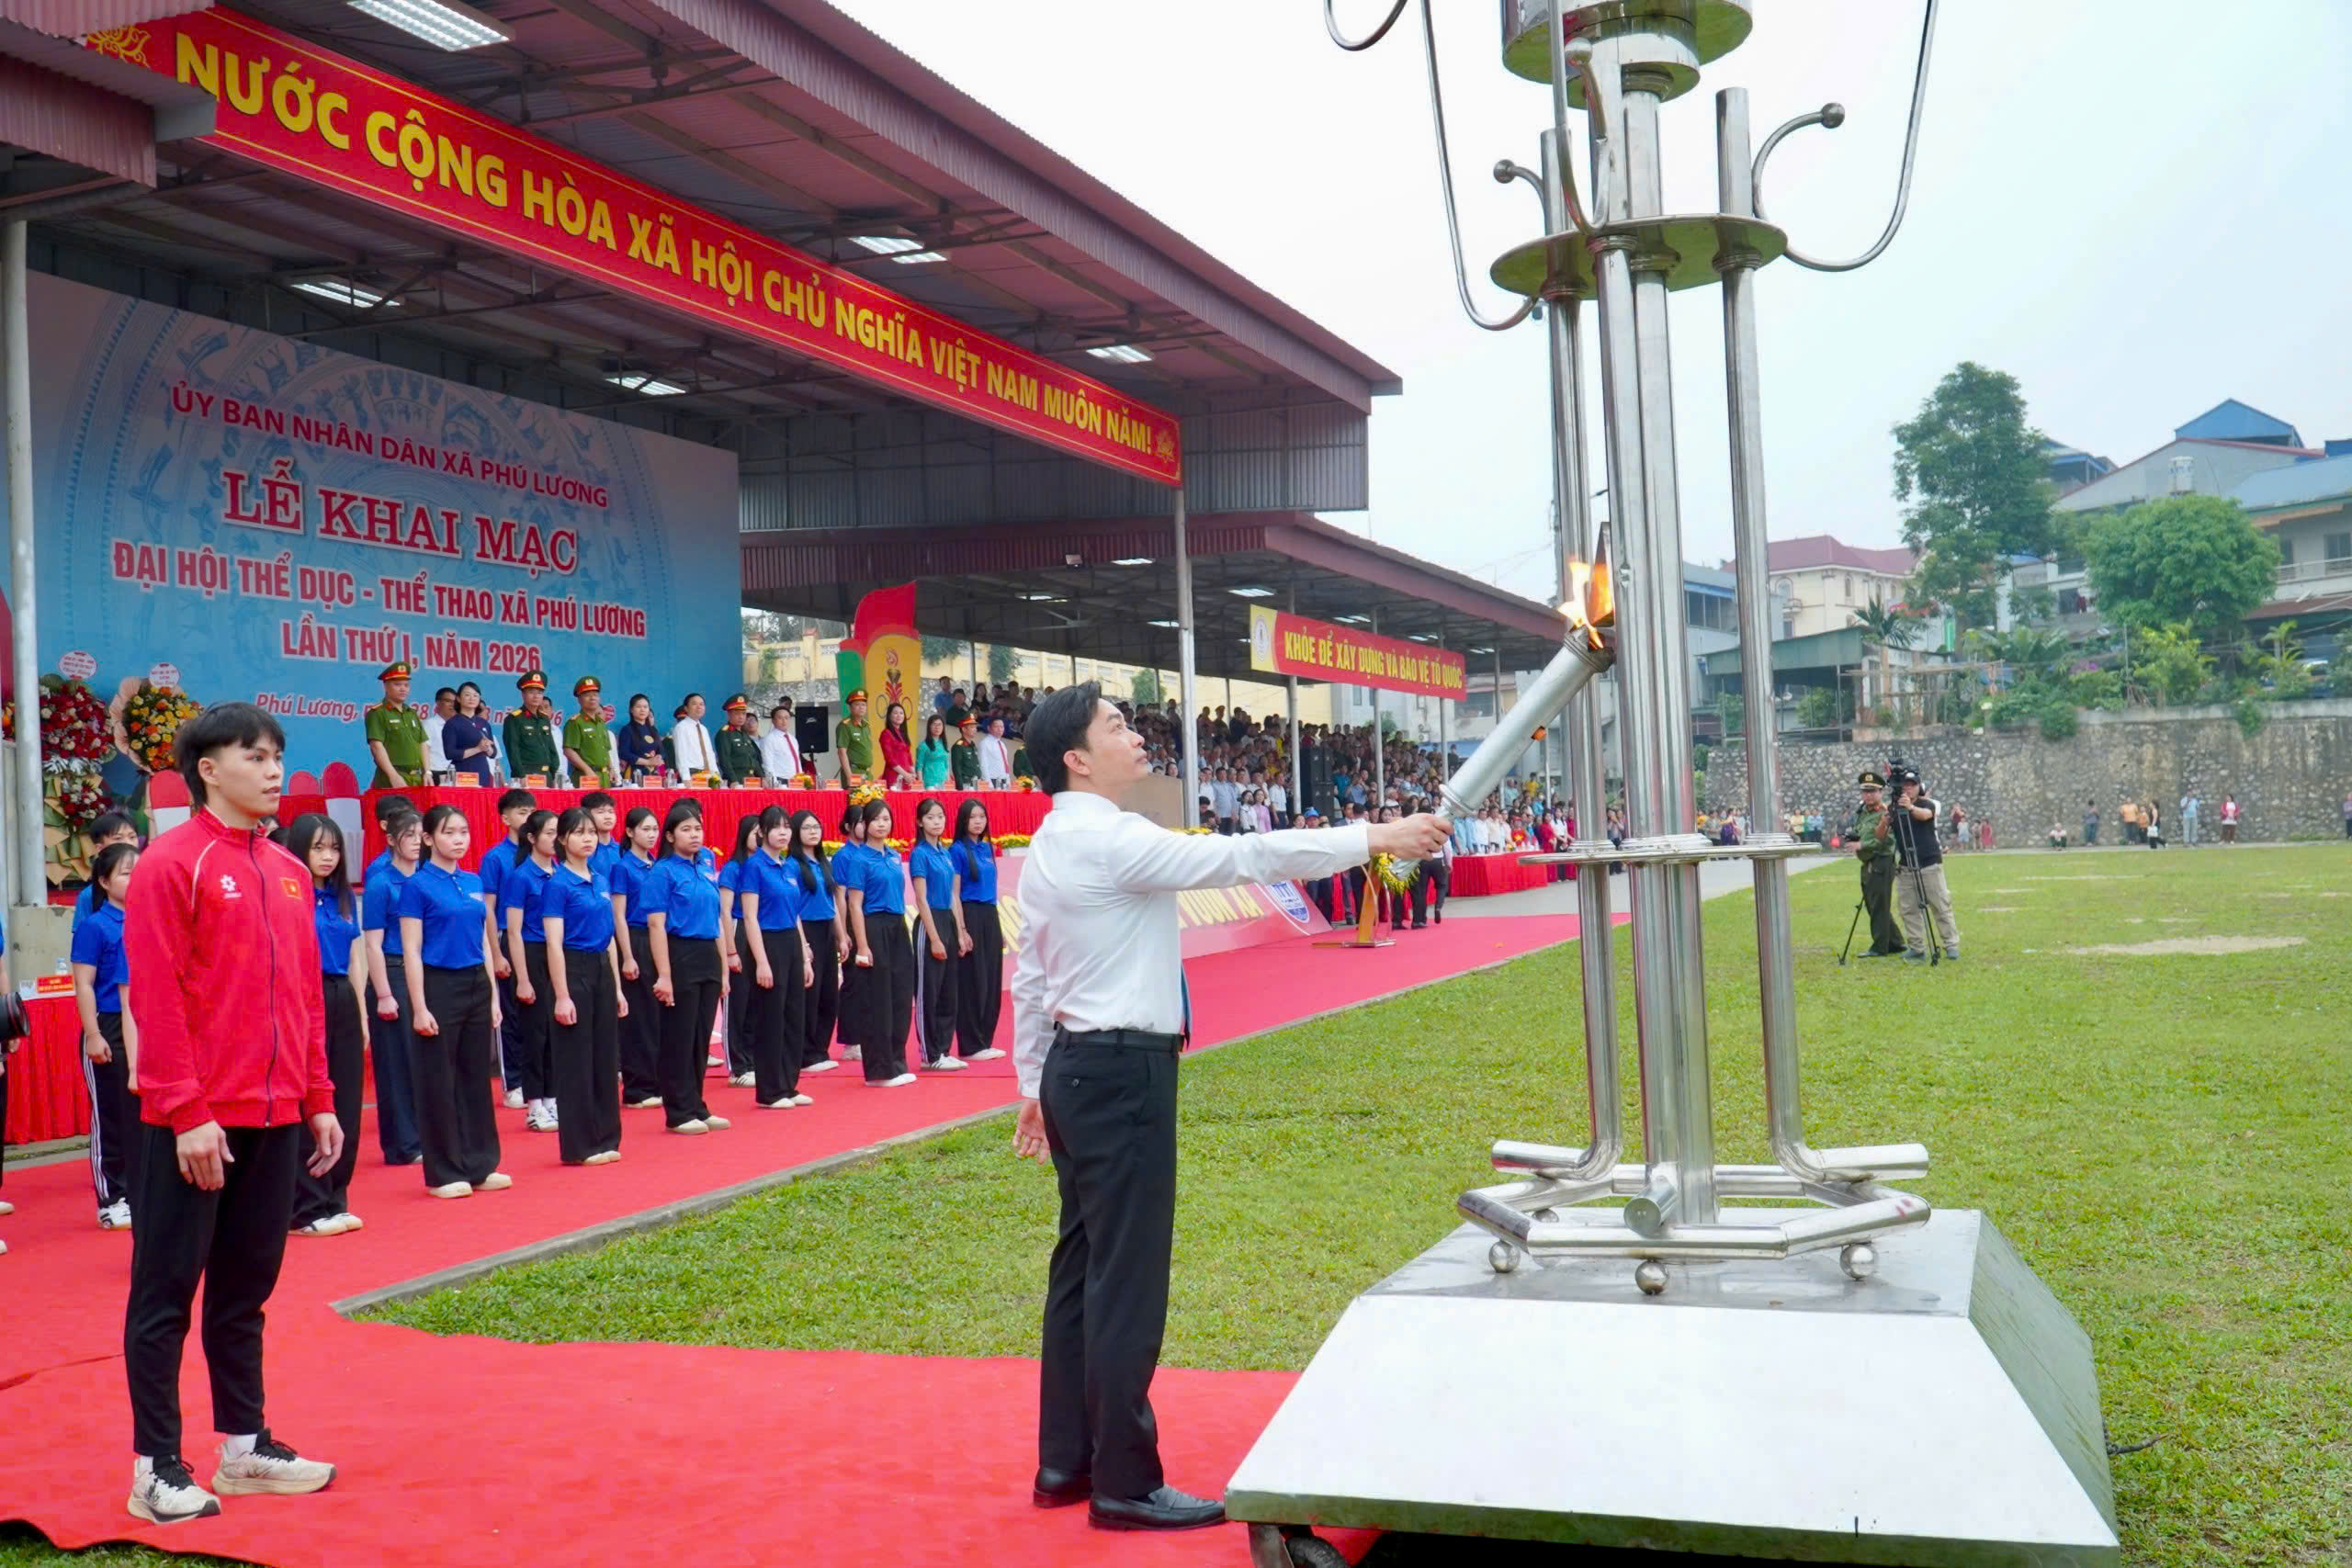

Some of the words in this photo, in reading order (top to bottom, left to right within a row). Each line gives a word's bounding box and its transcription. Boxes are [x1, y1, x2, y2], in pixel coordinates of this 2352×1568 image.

[176, 32, 350, 150] NƯỚC
[366, 108, 507, 207] CỘNG
[522, 169, 617, 251] HÒA
[628, 212, 682, 276] XÃ
[691, 239, 752, 307] HỘI
[763, 272, 826, 329] CHỦ
[835, 297, 924, 368] NGHĨA
[930, 338, 982, 393] VIỆT
[987, 359, 1037, 412] NAM
[1044, 389, 1102, 434] MUÔN
[1106, 405, 1152, 454] NĂM!
[172, 380, 214, 417] ỦY
[223, 399, 284, 434] BAN
[292, 415, 373, 455] NHÂN
[381, 437, 435, 469] DÂN
[443, 451, 474, 479] XÃ
[481, 460, 527, 489] PHÚ
[533, 472, 607, 507] LƯƠNG
[222, 459, 301, 531] LỄ
[318, 489, 459, 555] KHAI
[474, 515, 578, 576] MẠC
[113, 541, 168, 589] ĐẠI
[176, 547, 228, 596] HỘI
[237, 551, 291, 598] THỂ
[300, 567, 355, 610] DỤC
[380, 570, 428, 614] THỂ
[434, 584, 494, 621] THAO
[501, 590, 530, 626] XÃ
[537, 596, 577, 630] PHÚ
[583, 603, 646, 637] LƯƠNG
[282, 613, 337, 659] LẦN
[345, 625, 397, 663] THỨ
[425, 632, 481, 670] NĂM
[488, 643, 541, 674] 2026
[1284, 625, 1316, 664] KHỎE
[1336, 638, 1357, 671] XÂY
[1385, 649, 1398, 678] VÀ
[1442, 659, 1463, 690] QUỐC
[256, 694, 292, 714] Phú
[297, 696, 358, 722] Lương,
